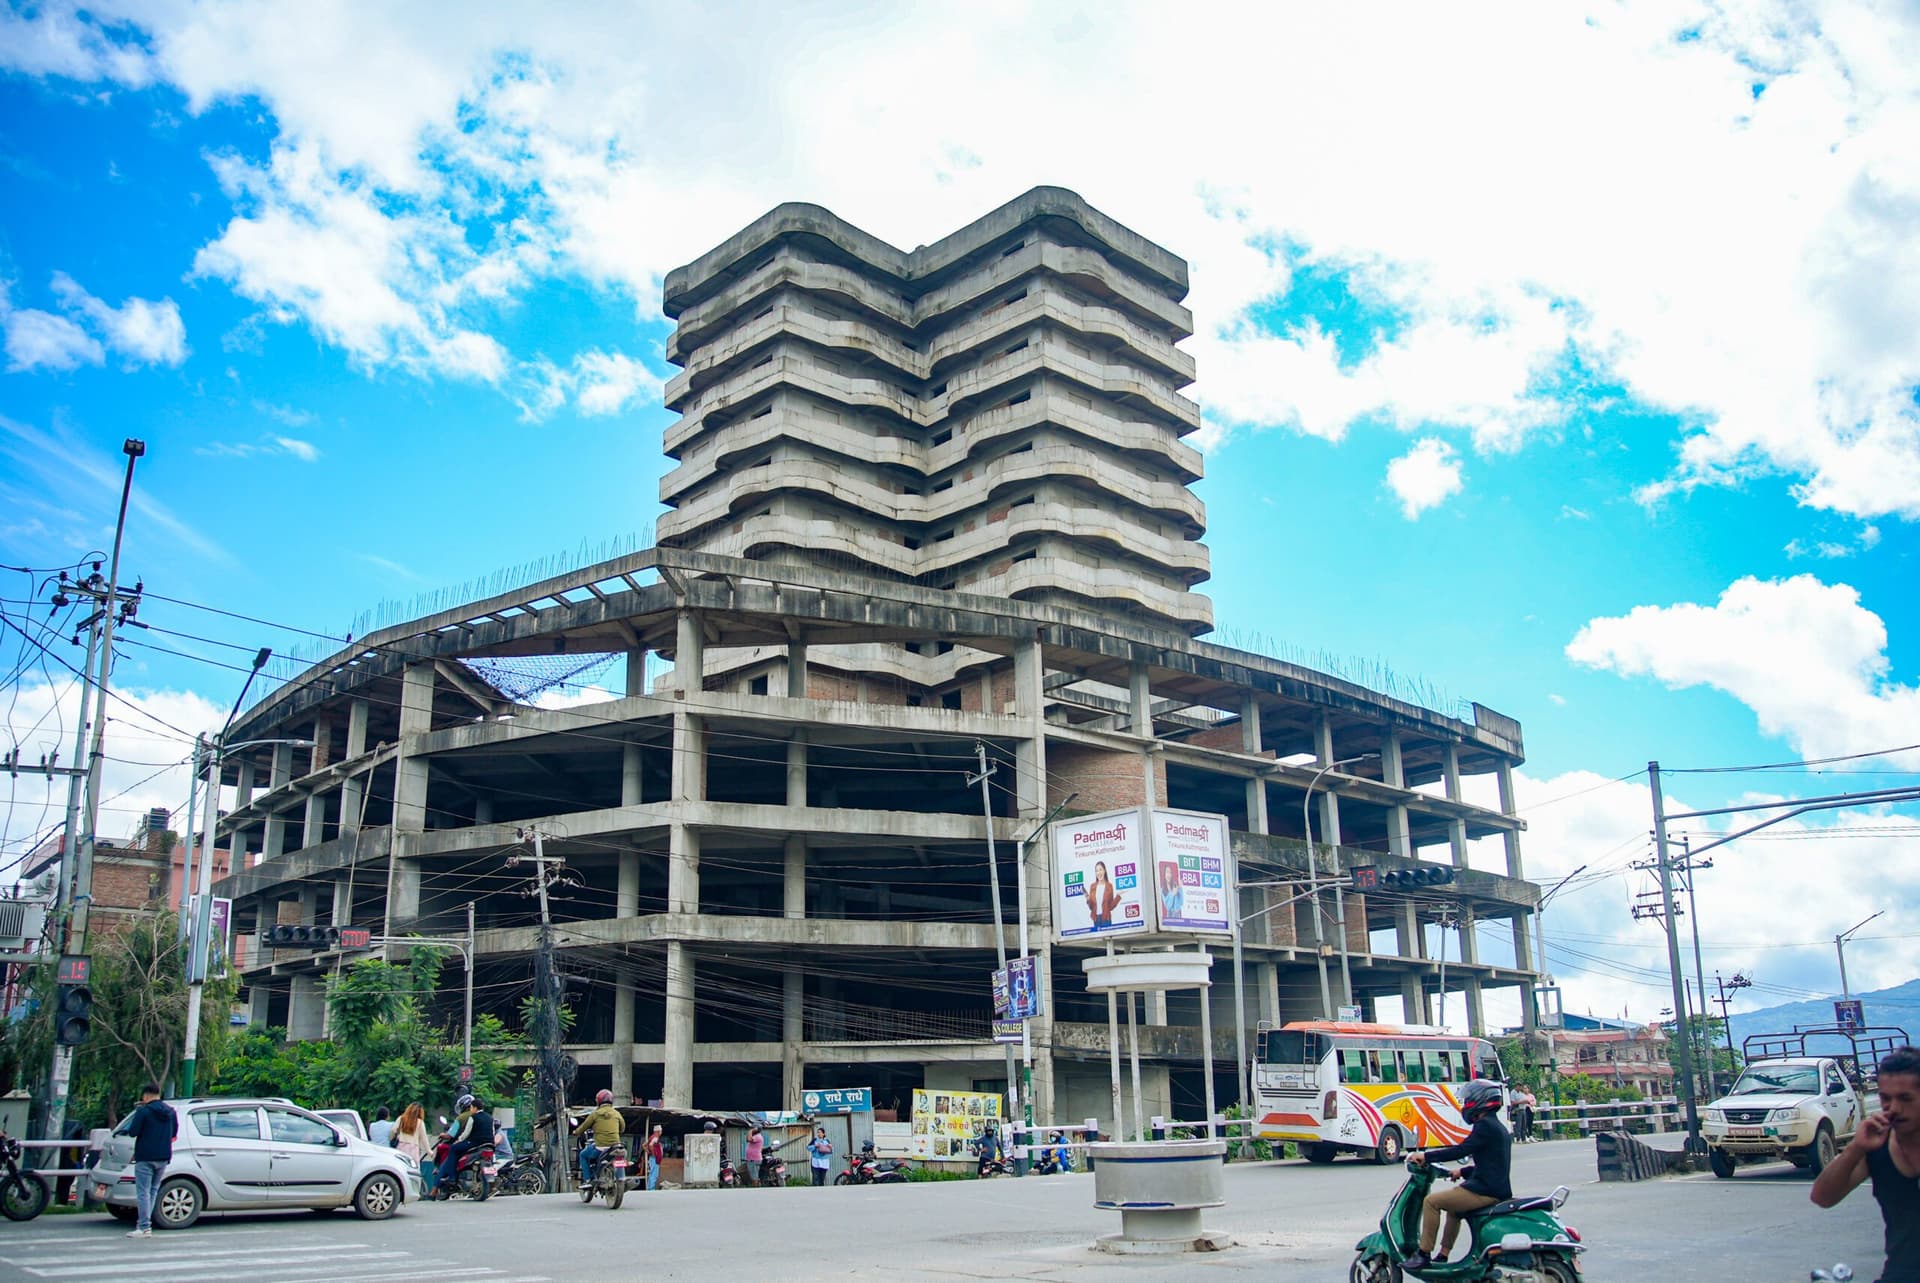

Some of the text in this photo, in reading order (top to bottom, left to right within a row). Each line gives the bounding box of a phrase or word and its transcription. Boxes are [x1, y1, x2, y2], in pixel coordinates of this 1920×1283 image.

[1183, 857, 1220, 870] BIT BHM
[1117, 865, 1133, 875] BBA
[1069, 873, 1080, 883] BIT
[1119, 878, 1134, 888] BCA
[1183, 873, 1219, 886] BBA BCA
[1067, 885, 1083, 896] BHM
[342, 930, 370, 947] STOP
[1002, 1023, 1023, 1034] COLLEGE
[824, 1089, 863, 1103] राधे राधे
